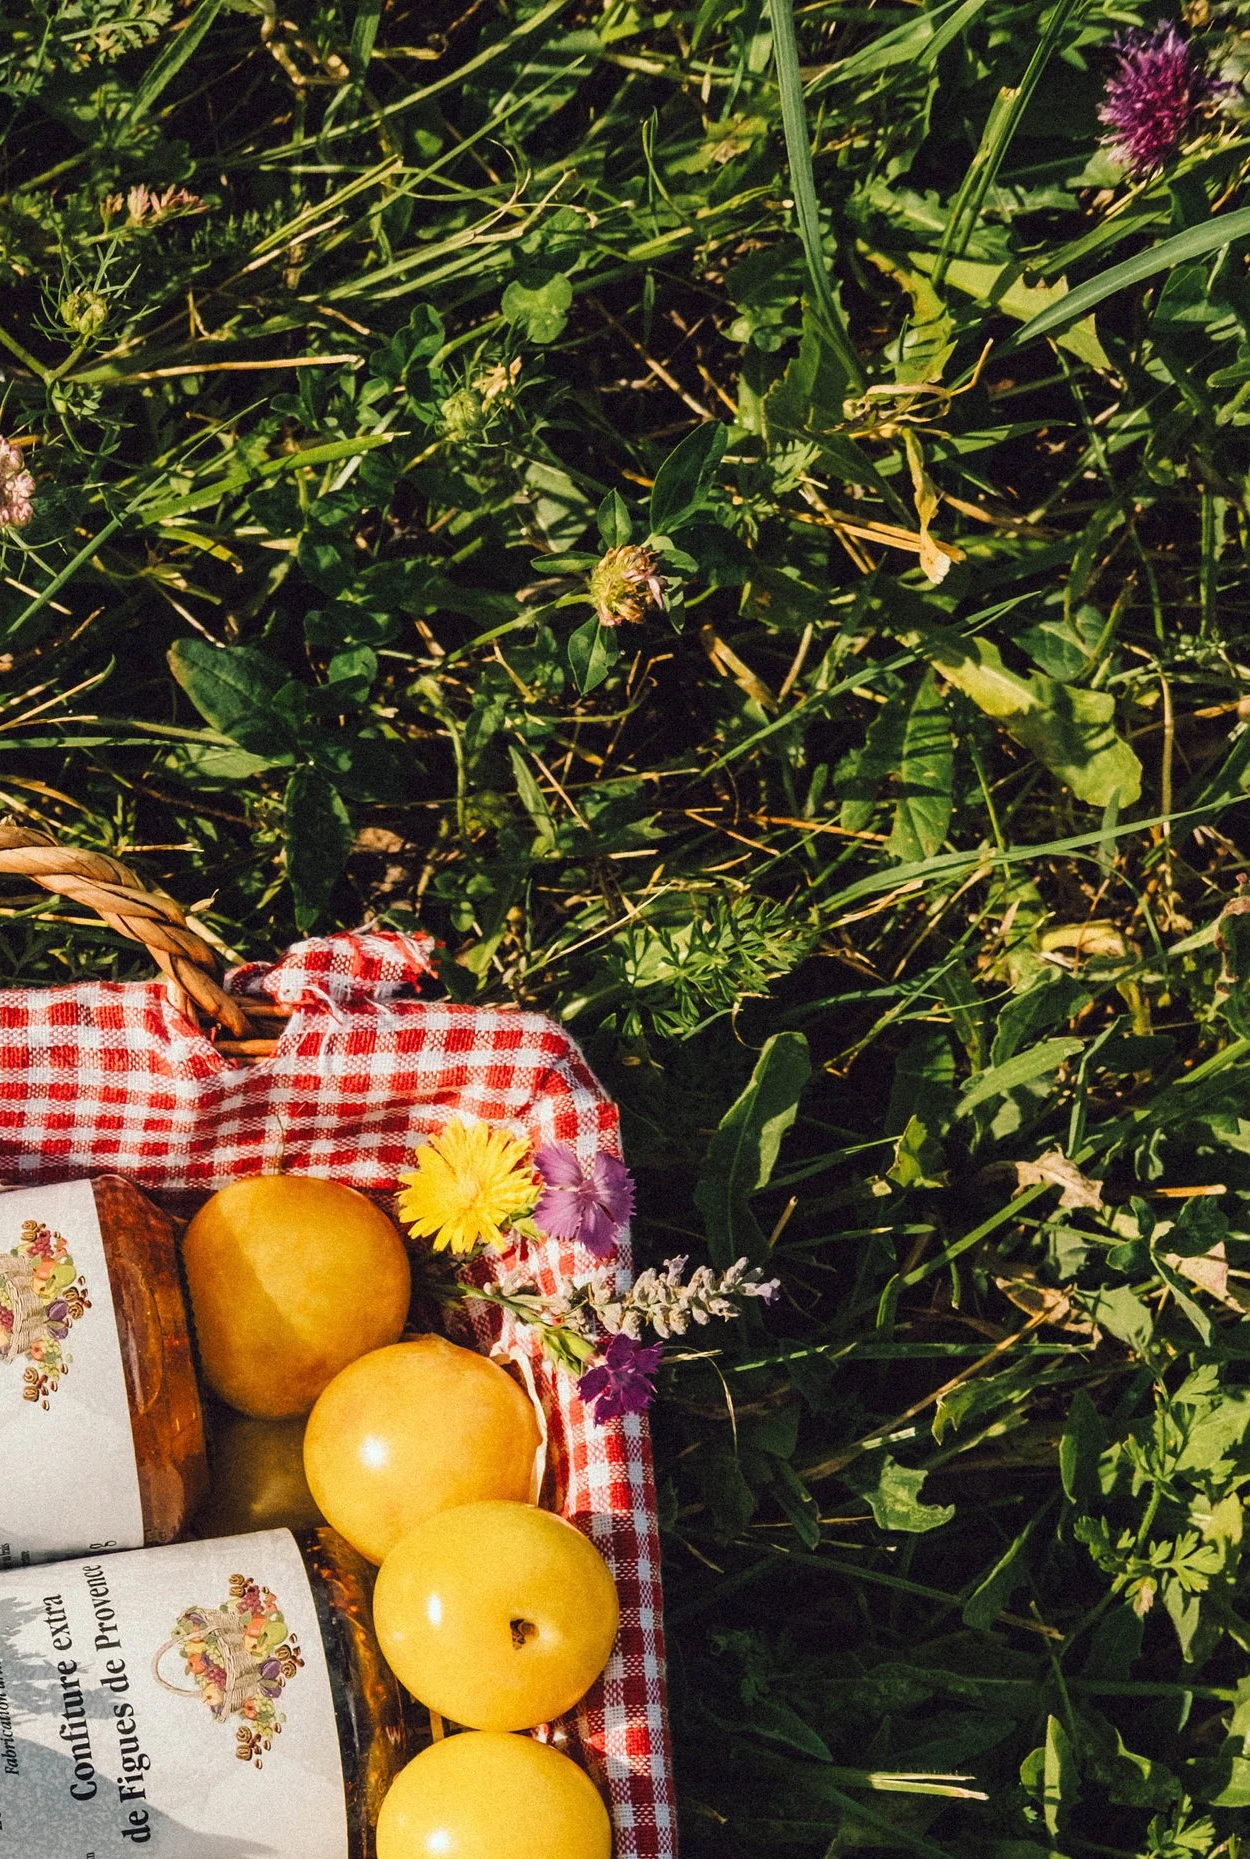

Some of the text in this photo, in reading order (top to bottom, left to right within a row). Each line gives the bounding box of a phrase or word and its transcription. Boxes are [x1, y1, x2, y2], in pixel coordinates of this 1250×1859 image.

[42, 1594, 98, 1801] Confiture extra
[81, 1564, 152, 1843] de Figues de Provence
